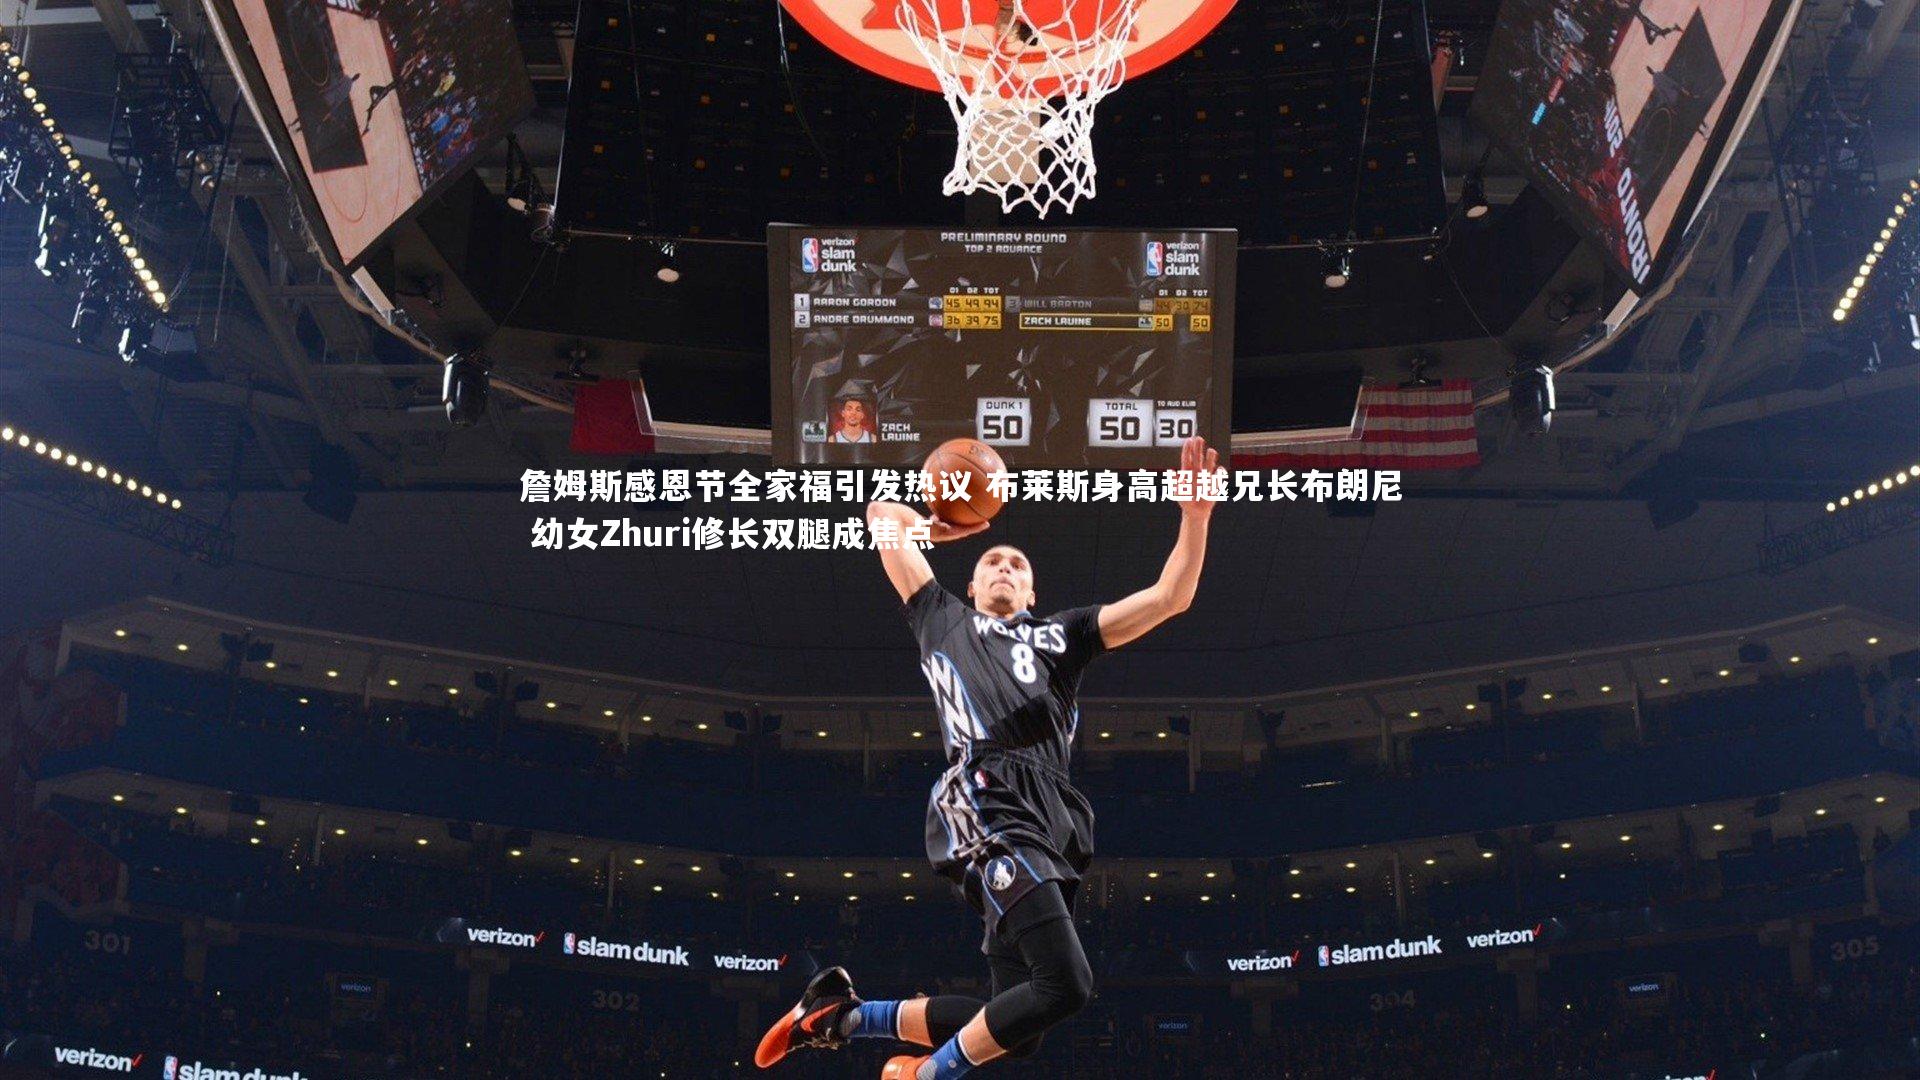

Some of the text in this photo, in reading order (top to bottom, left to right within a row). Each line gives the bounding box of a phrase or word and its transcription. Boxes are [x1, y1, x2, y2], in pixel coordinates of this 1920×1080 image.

[821, 237, 855, 246] verizon
[940, 231, 1067, 243] PRELIMINARY ROUND
[965, 244, 983, 253] TOP
[986, 245, 993, 253] 2
[1165, 242, 1200, 250] verizon
[821, 247, 856, 259] slam
[1165, 251, 1200, 263] slam
[821, 260, 857, 272] dunk
[1165, 263, 1200, 276] dunk
[813, 297, 850, 307] AARON
[852, 297, 897, 307] GORDON
[946, 298, 999, 308] 45 49 94
[813, 314, 850, 324] ANDRE
[852, 315, 915, 325] DRUMMOND
[965, 315, 980, 325] 39
[983, 316, 999, 326] 75
[1024, 316, 1052, 325] ZACH
[1156, 318, 1208, 328] 50 50
[986, 401, 1015, 410] DUNK
[1105, 402, 1138, 411] TOTAL
[881, 422, 911, 432] ZACH
[982, 414, 1023, 440] 50
[1100, 416, 1141, 441] 50
[1159, 418, 1193, 438] 30
[973, 615, 1067, 653] WOLVES
[1011, 643, 1036, 683] 8
[467, 926, 535, 947] verizon
[1467, 928, 1534, 949] verizon
[577, 936, 690, 967] slam dunk
[1331, 935, 1442, 965] slam dunk
[714, 953, 779, 972] verizon
[1227, 954, 1292, 972] verizon
[55, 1046, 132, 1072] verizon
